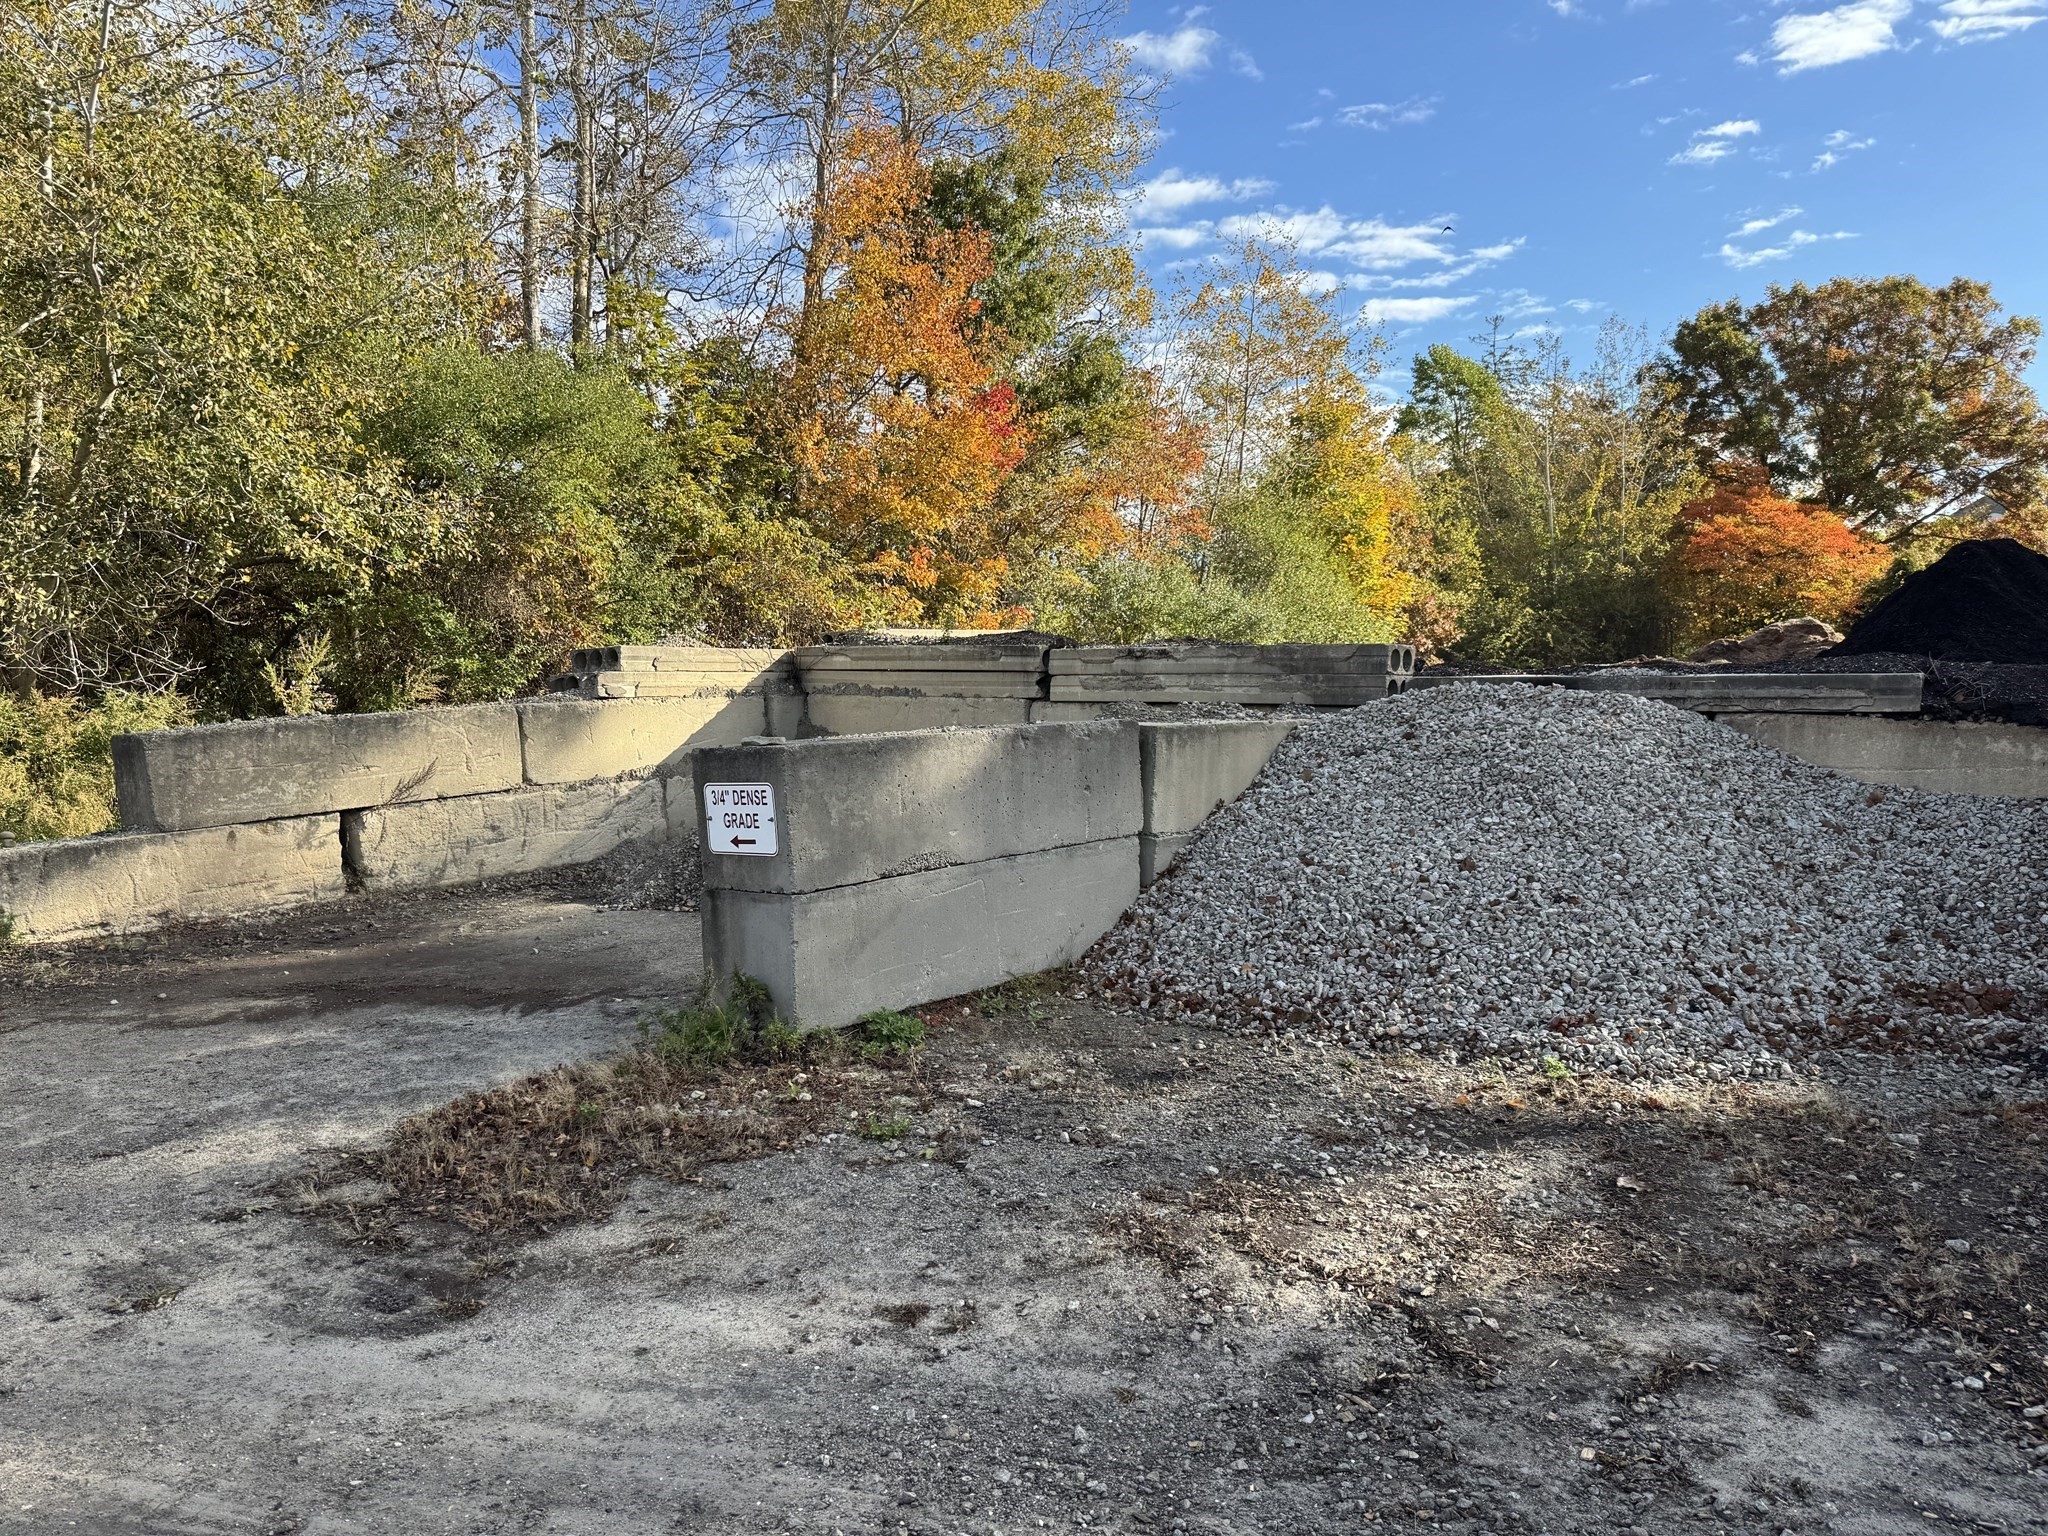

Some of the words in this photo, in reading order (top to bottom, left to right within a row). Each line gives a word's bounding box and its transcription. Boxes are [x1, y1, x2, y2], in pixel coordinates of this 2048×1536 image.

[711, 790, 729, 806] 3/4"
[732, 790, 768, 806] DENSE
[723, 813, 760, 829] GRADE
